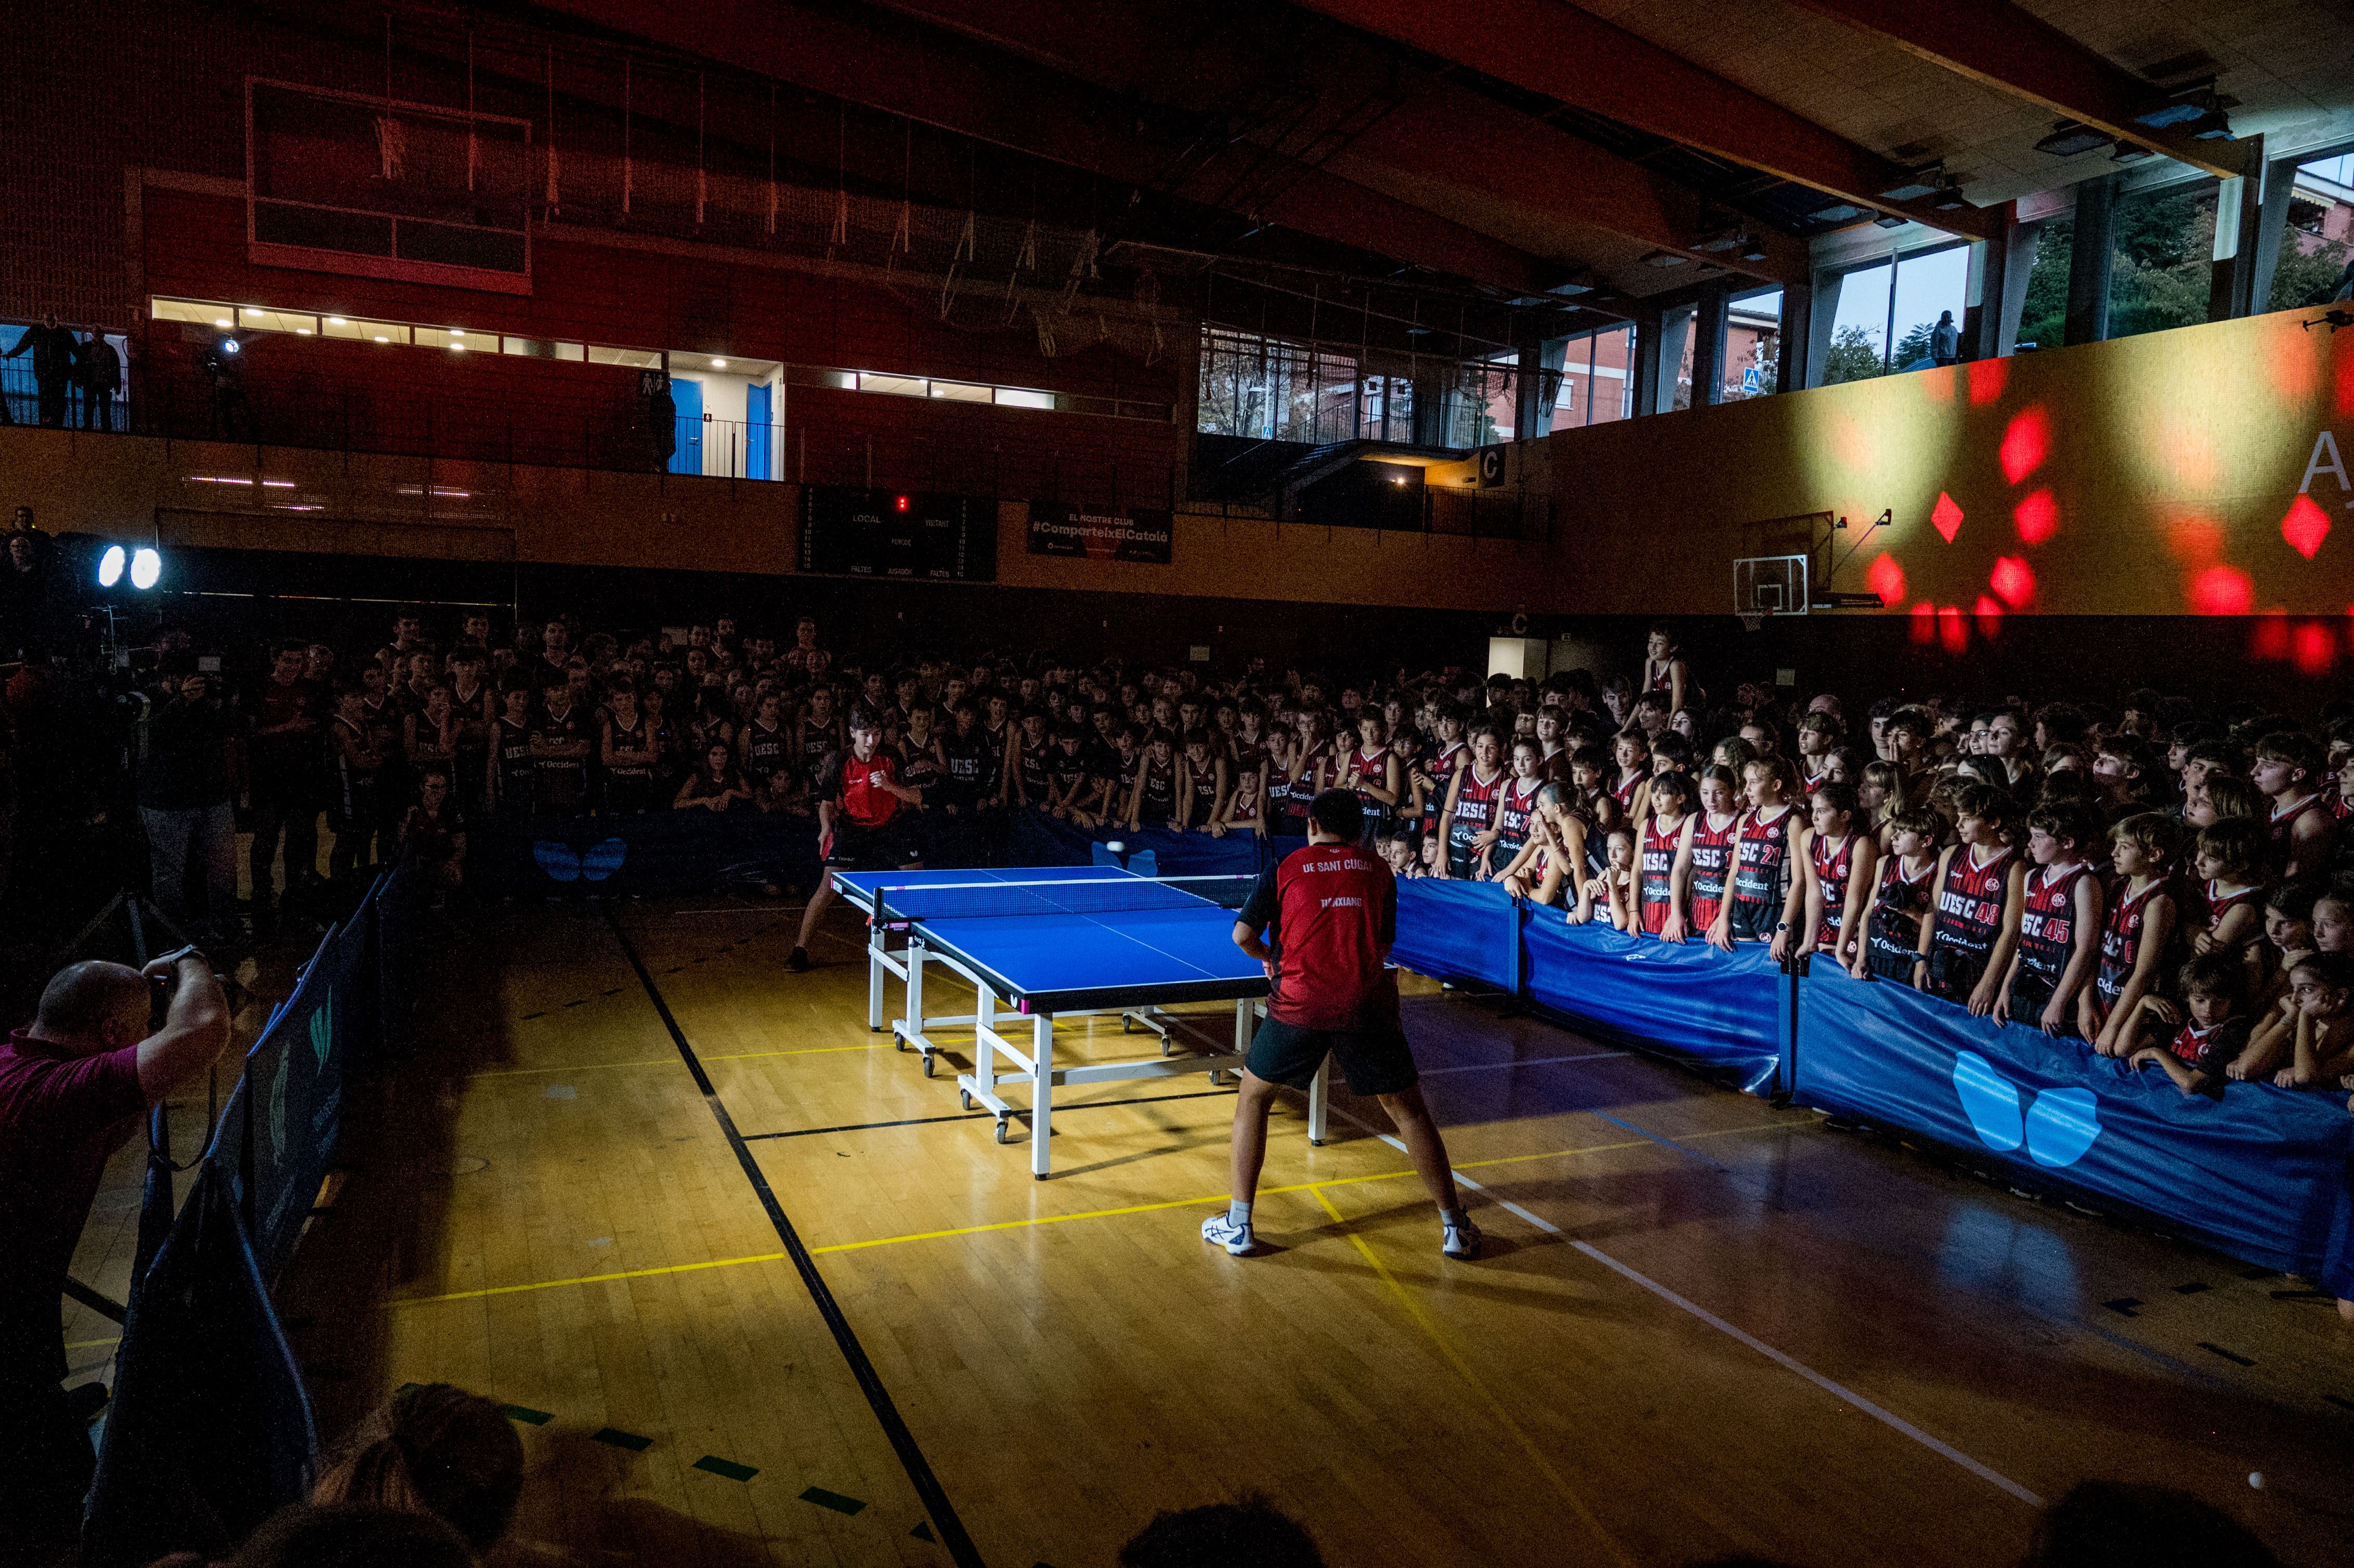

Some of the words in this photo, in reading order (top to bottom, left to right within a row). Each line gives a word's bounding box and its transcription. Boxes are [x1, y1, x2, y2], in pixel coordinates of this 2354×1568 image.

[1484, 451, 1498, 479] C
[2297, 430, 2352, 494] A
[853, 514, 881, 524] LOCAL
[1080, 514, 1111, 525] NOSTRE
[851, 565, 872, 573] FALTES
[1512, 612, 1529, 635] C
[754, 742, 780, 756] UESC
[950, 757, 979, 774] UESC
[1692, 848, 1721, 867] ESC
[1760, 844, 1782, 867] 21
[1302, 863, 1316, 873] UE
[1317, 860, 1341, 872] SANT
[1698, 882, 1724, 893] Occide
[1940, 891, 1976, 919] UESC
[1975, 901, 2000, 926] 48
[2043, 918, 2070, 944] 45
